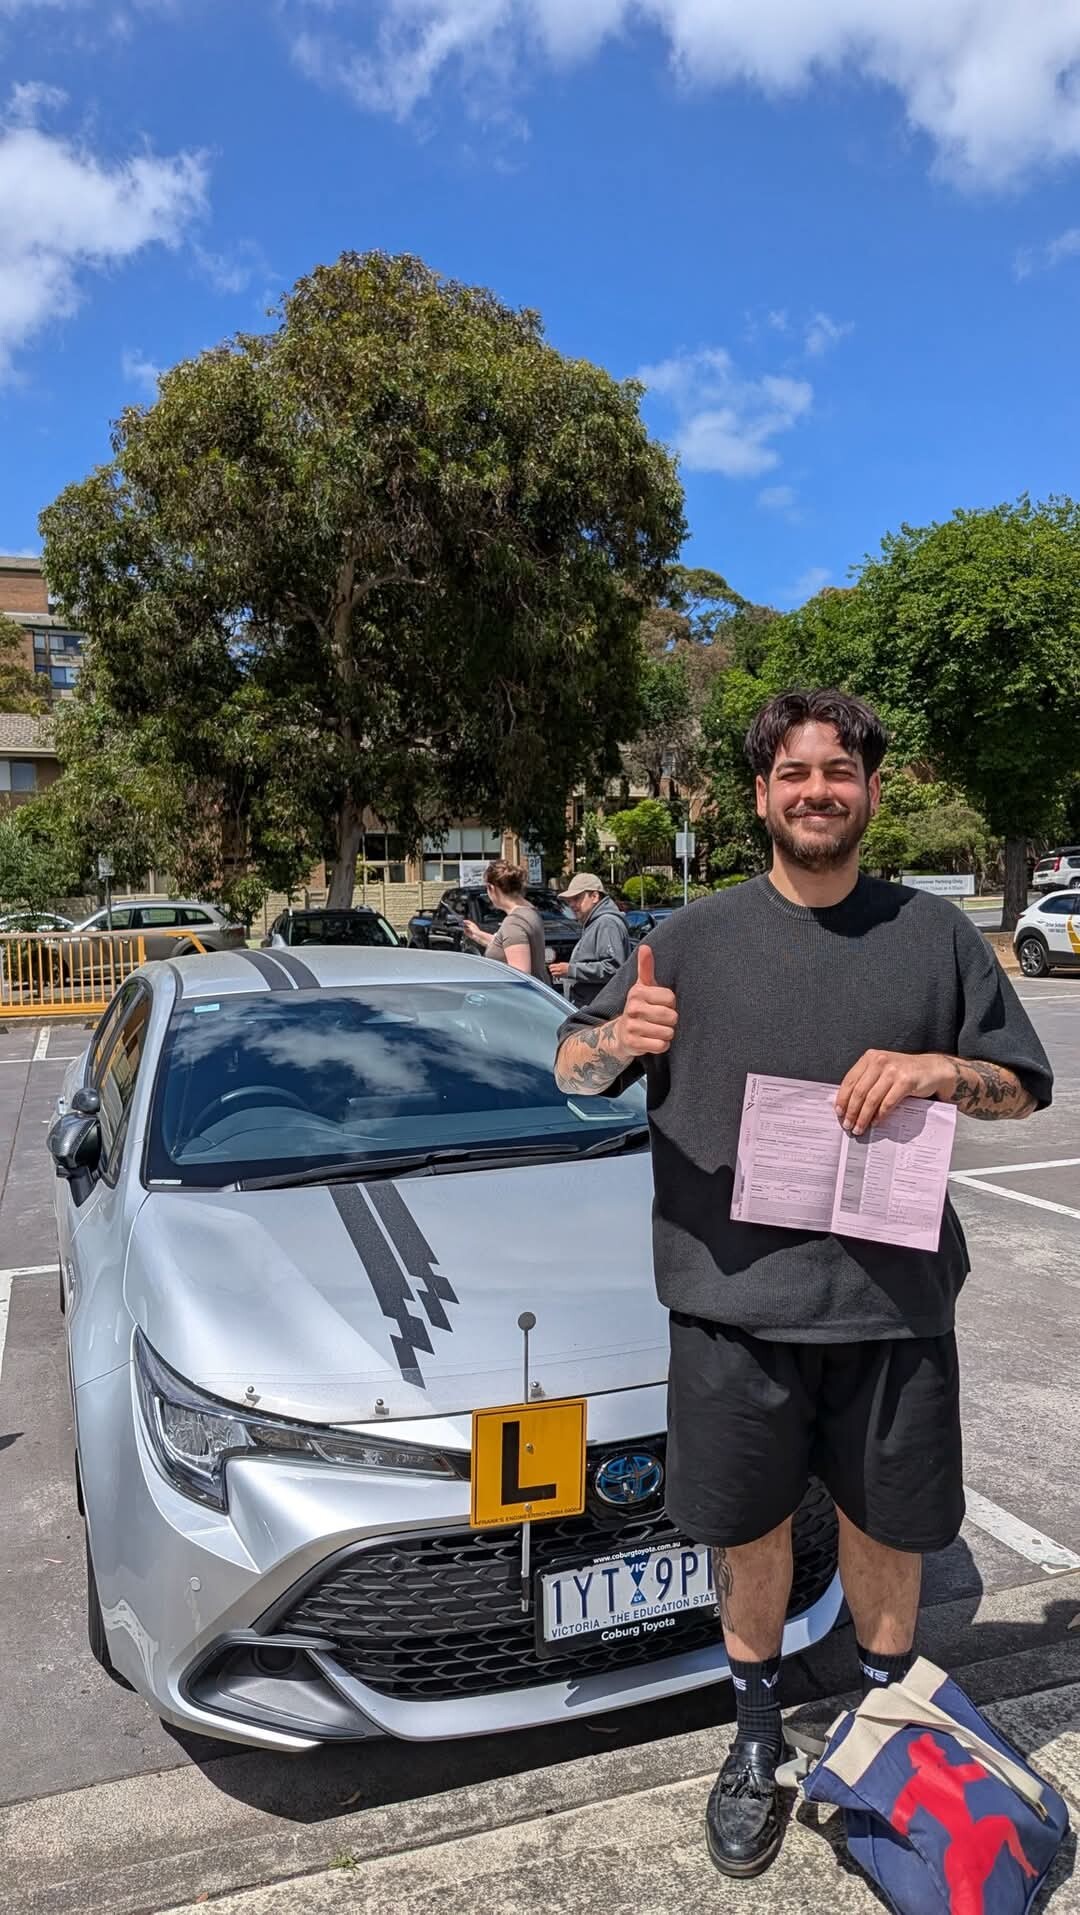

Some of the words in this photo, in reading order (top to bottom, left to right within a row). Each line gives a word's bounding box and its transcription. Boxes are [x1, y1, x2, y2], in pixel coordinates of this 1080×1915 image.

[501, 1421, 557, 1506] L
[593, 1541, 681, 1564] www.coburgtoyota.com.au
[630, 1561, 647, 1573] VIC
[551, 1619, 600, 1638] VICTORIA
[610, 1612, 630, 1625] THE
[633, 1597, 690, 1619] EDUCATION
[692, 1592, 717, 1606] STAT
[601, 1626, 640, 1641] Coburg
[641, 1617, 676, 1634] Toyota
